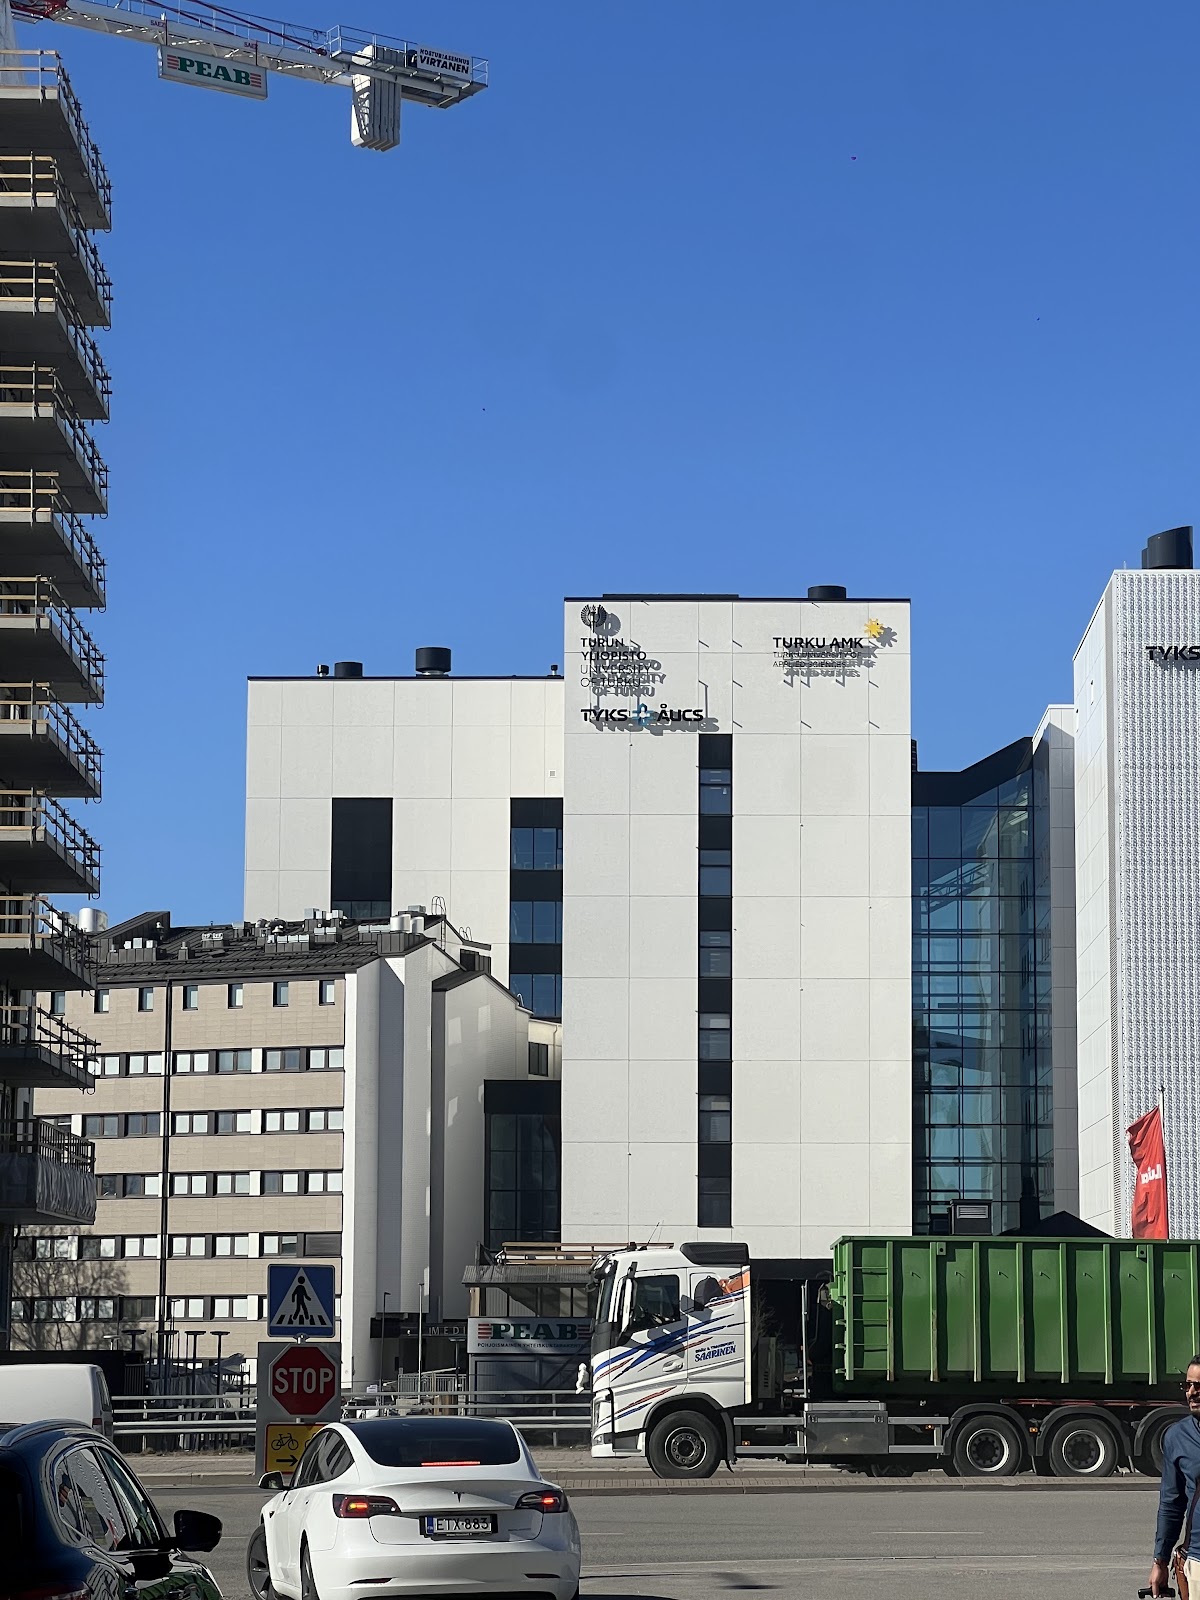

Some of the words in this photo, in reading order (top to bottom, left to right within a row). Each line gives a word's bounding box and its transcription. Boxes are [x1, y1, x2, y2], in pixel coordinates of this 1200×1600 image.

[178, 56, 251, 86] PEAB
[420, 55, 469, 74] VIRTANEN
[580, 637, 624, 648] TURUN
[773, 637, 826, 649] TURKU
[829, 637, 864, 649] AMK
[580, 651, 647, 661] YLIOPISTO
[1145, 645, 1200, 661] TYKS
[580, 664, 651, 675] UNIVERSITY
[580, 709, 628, 722] TYKS
[490, 1323, 578, 1340] PEAB
[695, 1345, 737, 1363] SAARINEN
[274, 1367, 334, 1394] STOP
[436, 1517, 489, 1531] ETX-883
